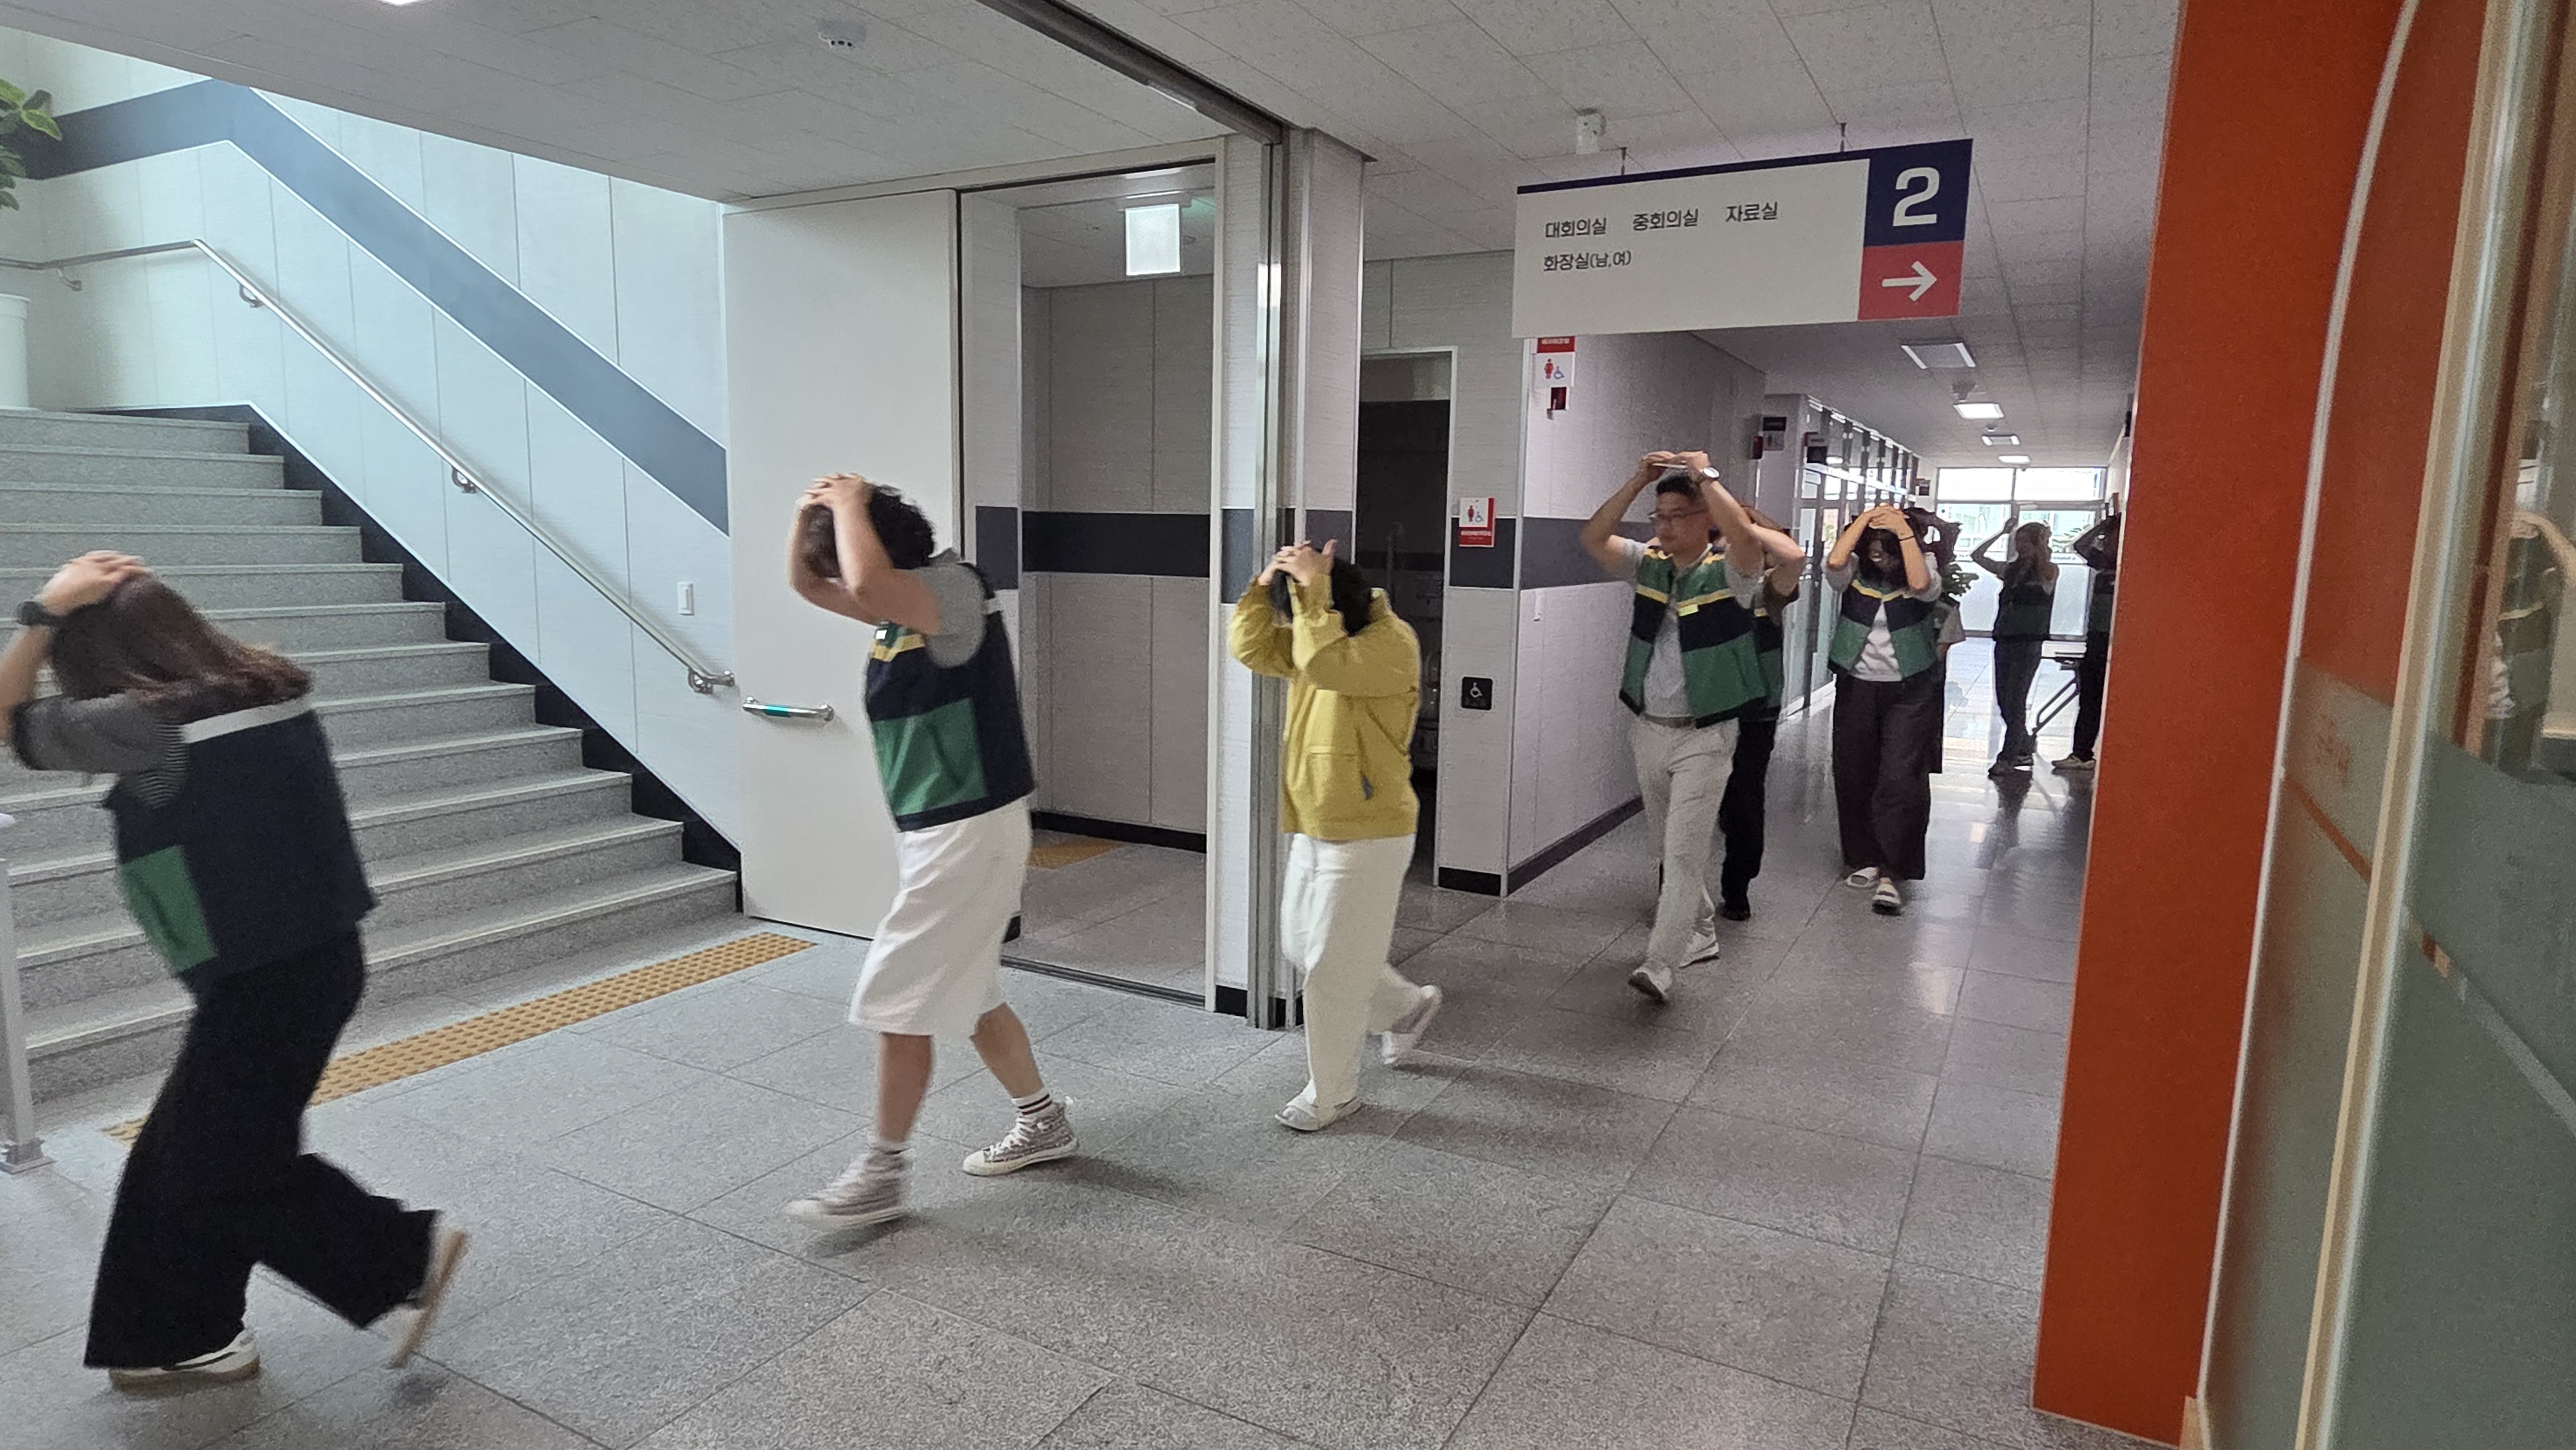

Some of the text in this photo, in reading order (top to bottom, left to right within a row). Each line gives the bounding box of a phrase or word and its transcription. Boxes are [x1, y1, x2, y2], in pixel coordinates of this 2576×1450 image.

[1893, 167, 1940, 227] 2
[1544, 201, 1779, 238] 대회의실 중회의실 자료실
[1543, 250, 1633, 272] 화장실(남,여)
